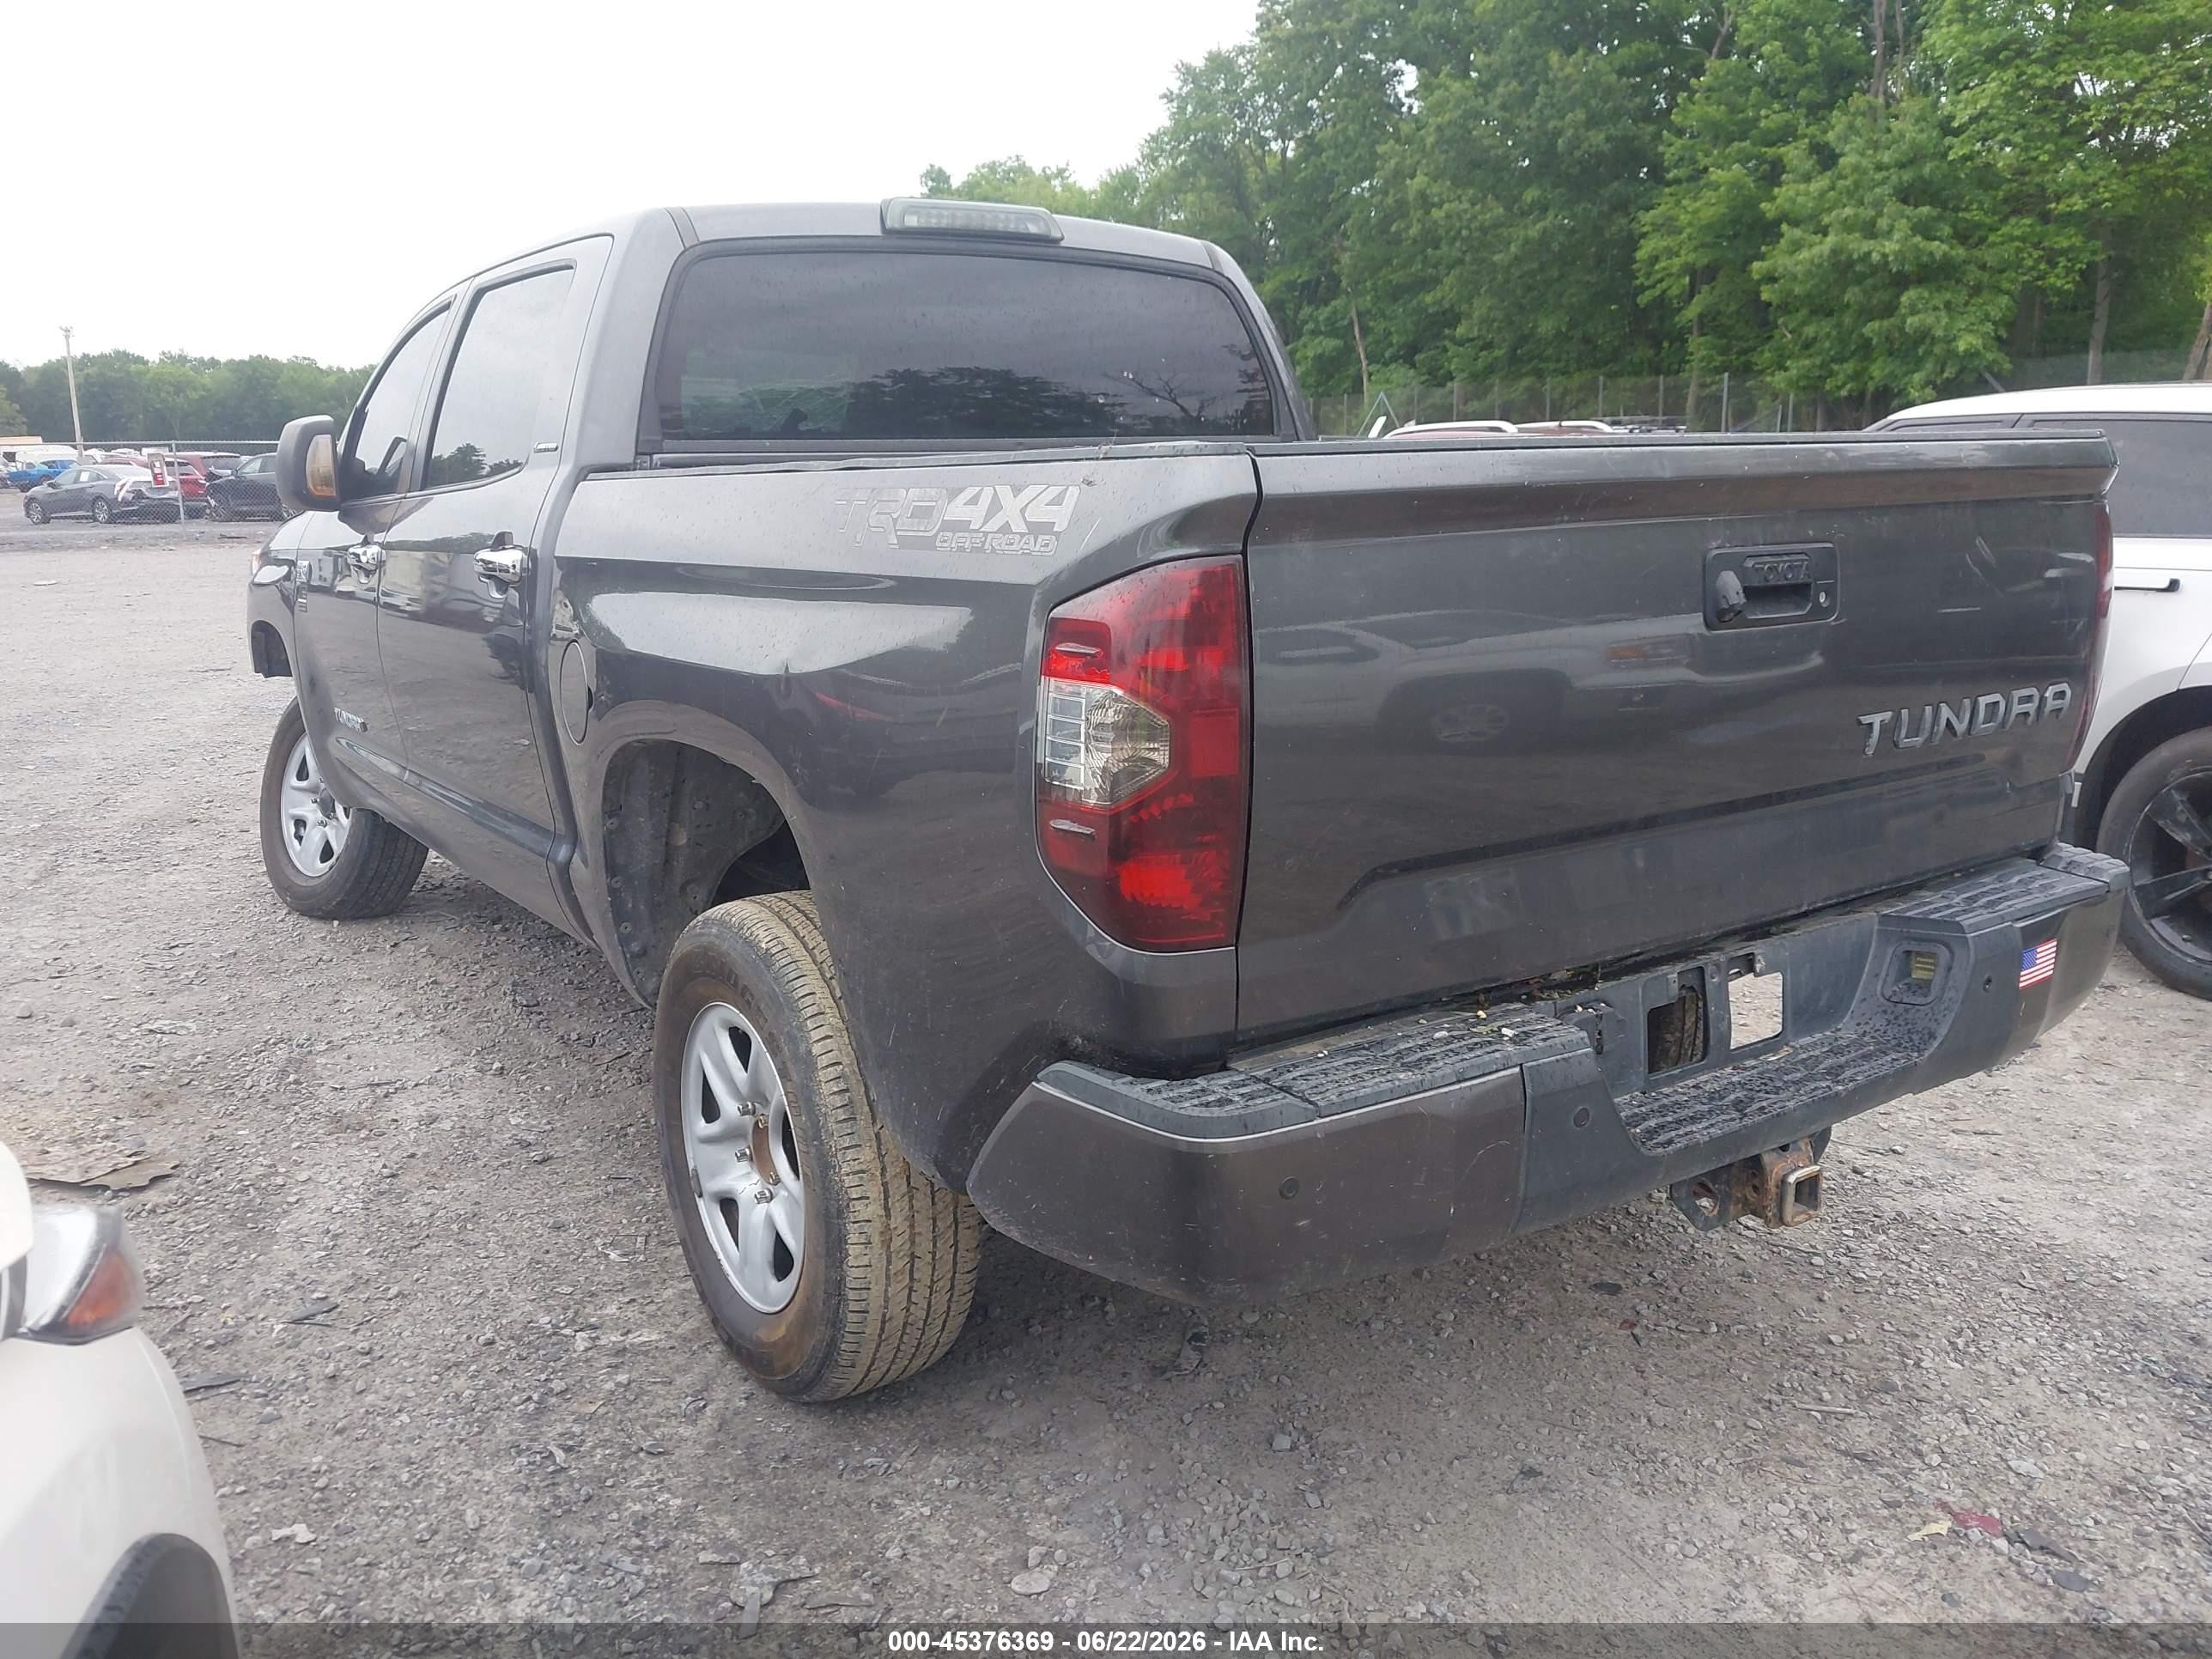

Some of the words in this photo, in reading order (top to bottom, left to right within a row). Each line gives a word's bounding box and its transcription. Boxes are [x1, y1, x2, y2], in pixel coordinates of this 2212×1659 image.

[834, 487, 948, 549] TRD
[942, 484, 1081, 533] 4X4
[935, 531, 985, 552] OFF
[983, 532, 1058, 556] ROAD
[1753, 561, 1810, 581] TOYOTA
[1857, 682, 2073, 756] TUNDRA
